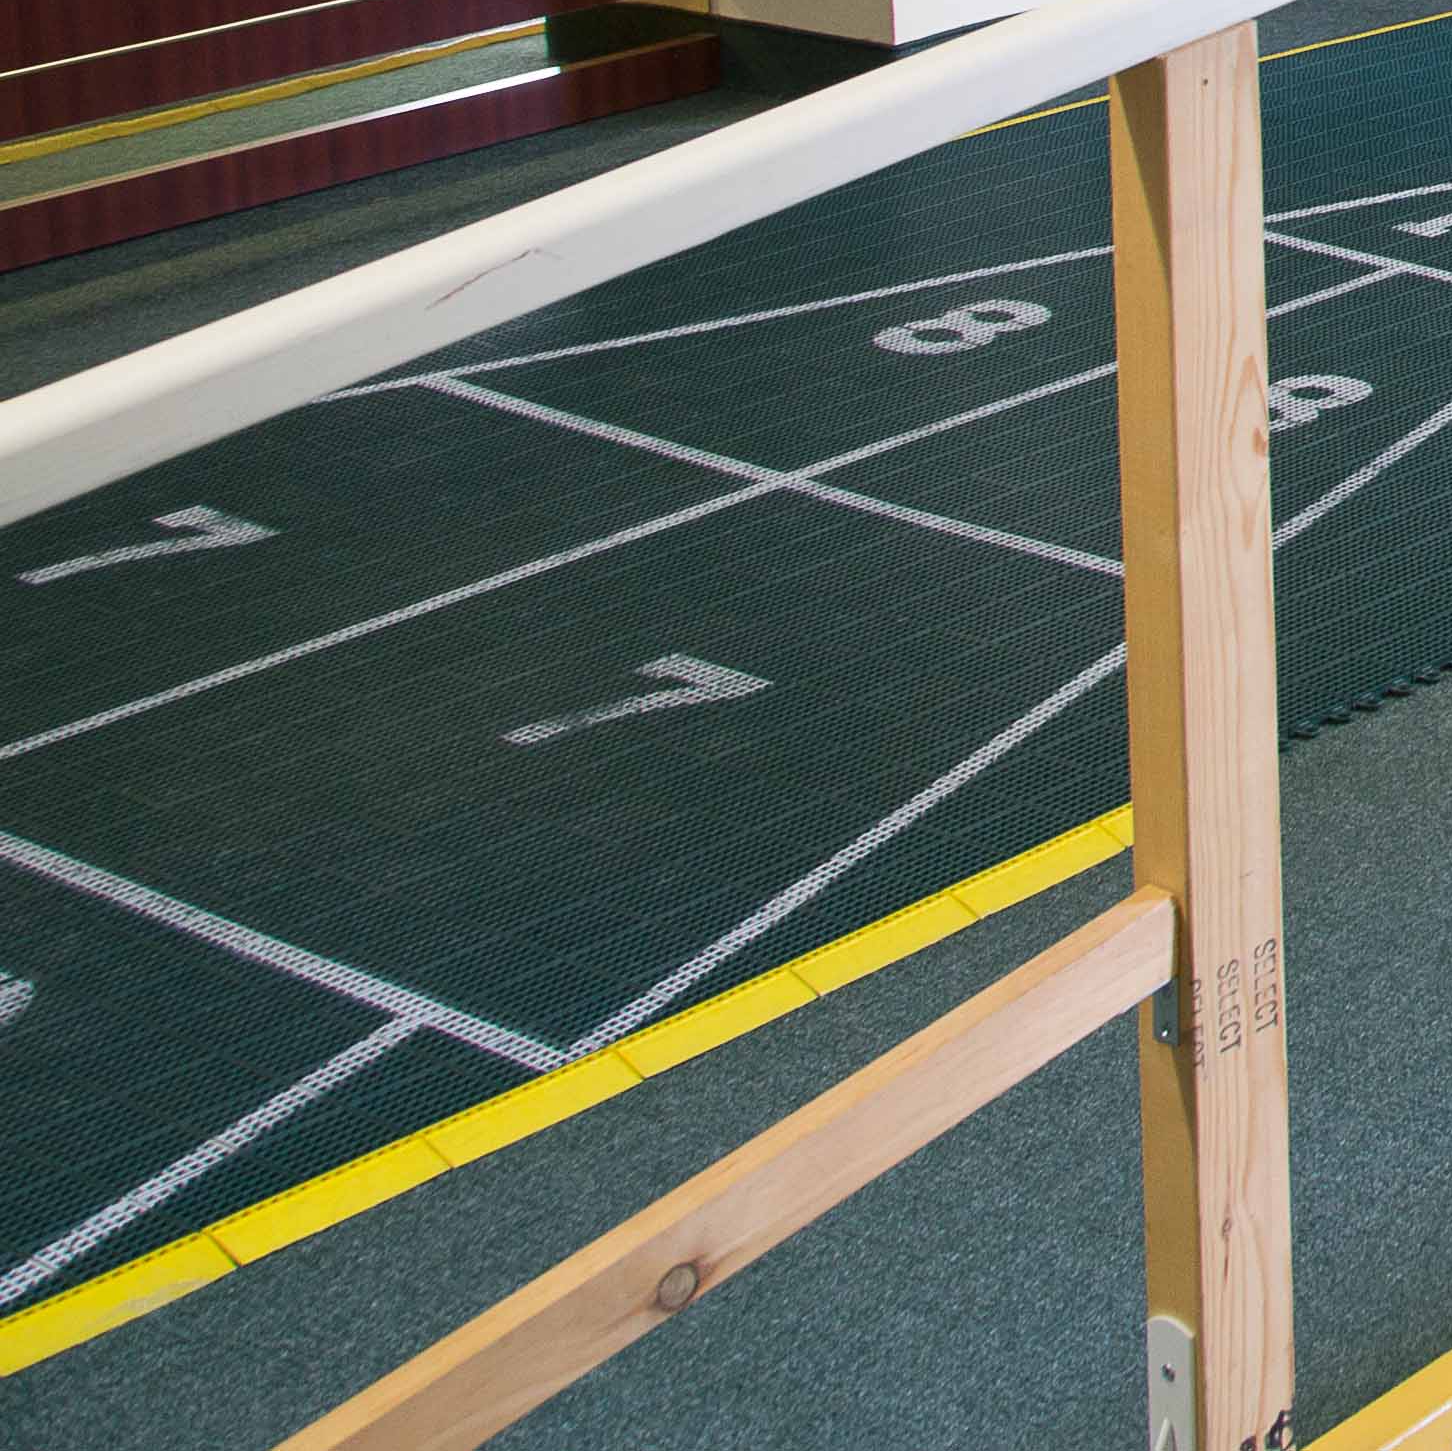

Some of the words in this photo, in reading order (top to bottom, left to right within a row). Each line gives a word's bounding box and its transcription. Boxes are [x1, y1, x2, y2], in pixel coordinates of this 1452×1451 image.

[872, 298, 1053, 356] 8
[16, 504, 281, 584] 7
[500, 652, 775, 745] 7
[1217, 958, 1242, 1054] SELECT
[1254, 937, 1278, 1033] SELECT
